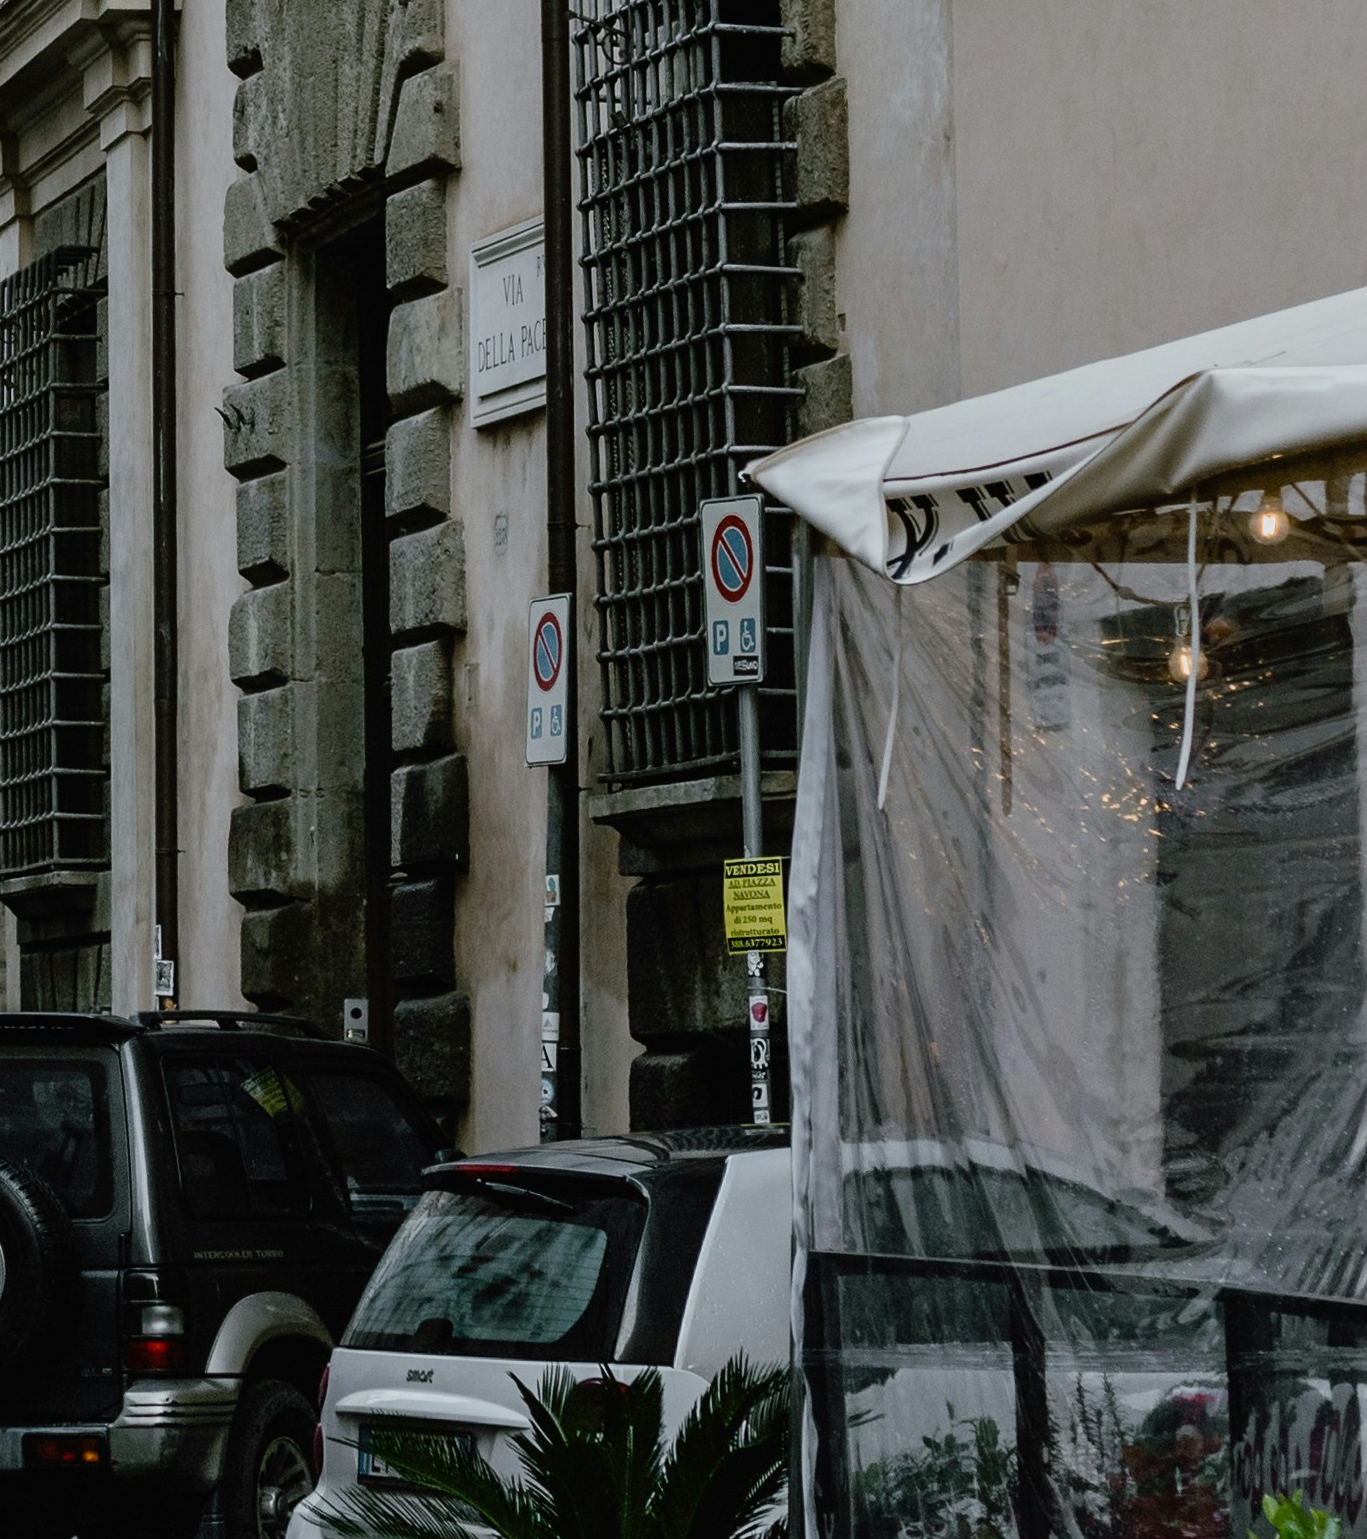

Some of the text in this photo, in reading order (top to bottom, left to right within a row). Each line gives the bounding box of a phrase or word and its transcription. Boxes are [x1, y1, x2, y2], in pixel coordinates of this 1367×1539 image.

[502, 273, 524, 307] VIA
[477, 331, 516, 373] DELLA
[725, 862, 780, 877] VENDESI
[743, 877, 776, 887] PIAZZA
[733, 890, 771, 901] NAVONA
[726, 902, 782, 914] Appartamento
[743, 915, 757, 924] 250
[758, 915, 773, 925] mq
[406, 1368, 434, 1384] smart
